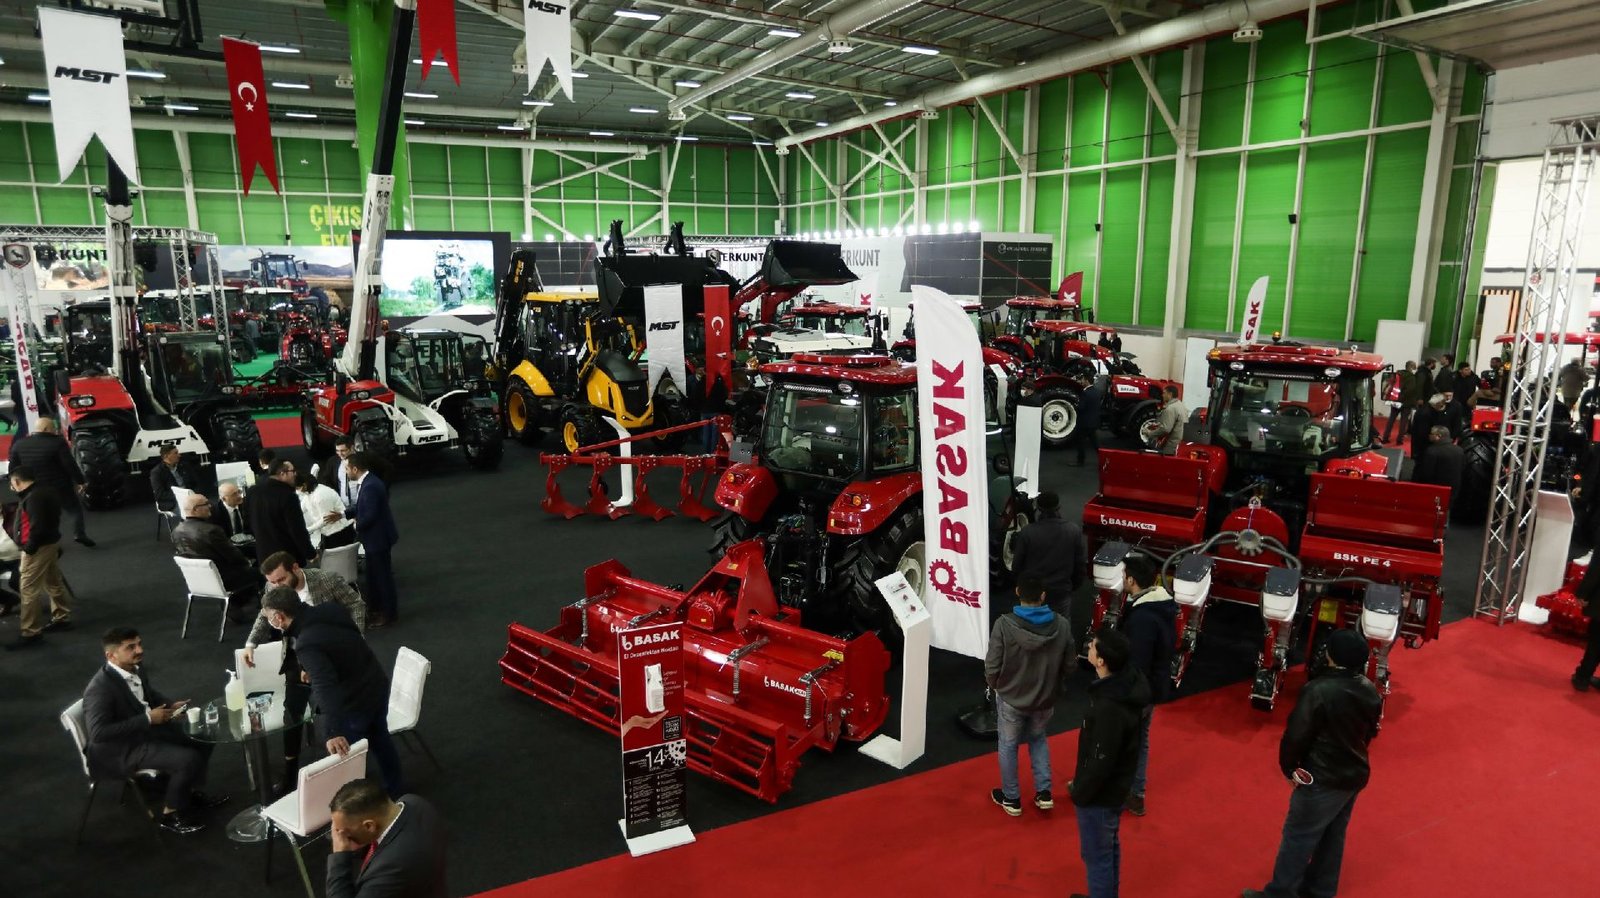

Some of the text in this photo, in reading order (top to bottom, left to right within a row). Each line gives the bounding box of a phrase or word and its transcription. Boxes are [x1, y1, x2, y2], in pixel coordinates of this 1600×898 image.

[528, 0, 567, 15] MST
[54, 65, 121, 84] MST
[722, 252, 764, 262] ERKUNT
[648, 320, 680, 332] MST
[1245, 300, 1260, 341] SAK
[147, 437, 186, 448] MST
[418, 434, 445, 443] MST
[1108, 518, 1140, 529] BASAK
[1333, 552, 1359, 562] BSK
[1363, 556, 1379, 565] PE
[634, 629, 680, 646] BASAK
[770, 679, 795, 694] BASAK
[645, 748, 665, 769] 14
